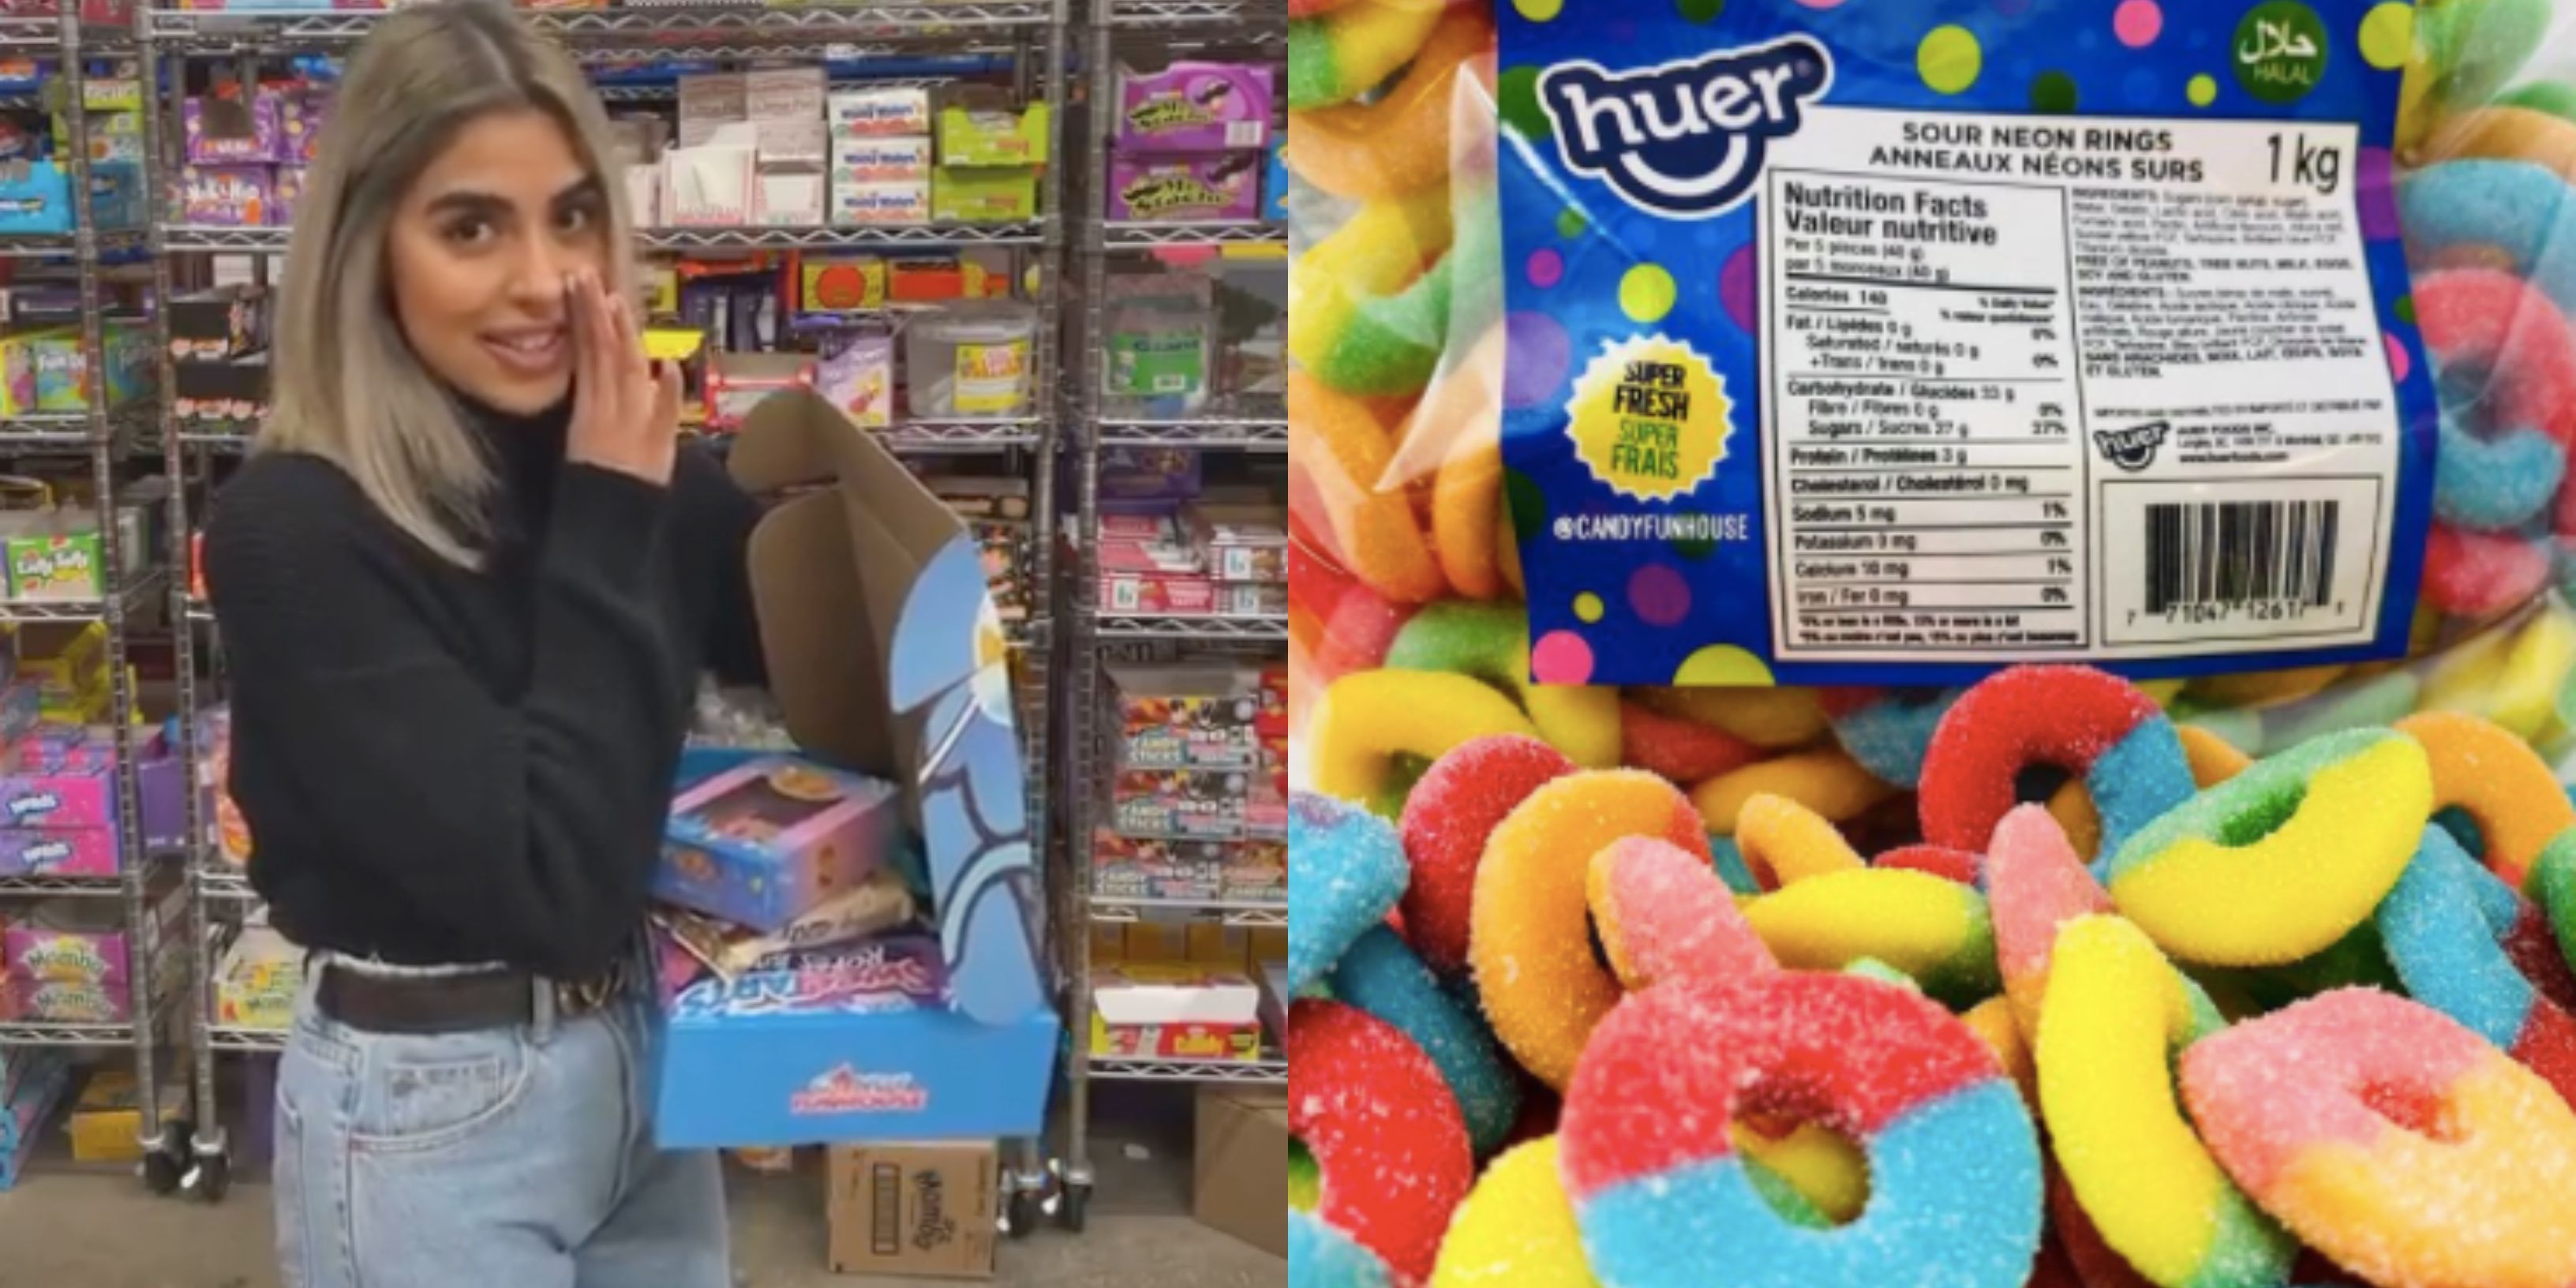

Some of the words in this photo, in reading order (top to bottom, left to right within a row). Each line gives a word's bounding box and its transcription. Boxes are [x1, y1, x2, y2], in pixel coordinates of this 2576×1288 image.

[2239, 18, 2318, 64] حلال
[2252, 63, 2312, 85] HALAL
[1902, 122, 1983, 145] SOUR
[1991, 126, 2076, 149] NEON
[2084, 129, 2174, 152] RINGS
[1869, 146, 2012, 173] ANNEAUX
[2022, 152, 2122, 178] NÉONS
[2130, 159, 2203, 183] SURS
[2267, 133, 2282, 183] 1
[2292, 133, 2339, 194] kg
[1784, 181, 1905, 213] Nutrition
[1914, 189, 1989, 218] Facts
[1783, 208, 1873, 237] Valeur
[1881, 218, 1999, 246] nutritive
[1784, 237, 1810, 252] Per
[1785, 286, 1849, 303] Calories
[1826, 316, 1883, 335] Lipides
[1805, 335, 1881, 353] Saturated
[1623, 360, 1688, 388] SUPER
[1788, 380, 1896, 399] Carbohydrate
[1612, 384, 1690, 421] FRESH
[1863, 402, 1911, 417] Fibres
[1619, 419, 1679, 447] SUPER
[1807, 419, 1863, 440] Sugars
[1878, 419, 1931, 436] Sucres
[1612, 444, 1679, 480] FRAIS
[1790, 446, 1848, 464] Protein
[1791, 475, 1881, 493] Cholesterol
[2005, 476, 2030, 494] mg
[1792, 504, 1853, 522] Sodium
[1870, 506, 1896, 523] mg
[1552, 513, 1748, 540] @CANDYFUNHOUSE
[1794, 534, 1874, 551] Potassium
[1892, 534, 1917, 552] mg
[1795, 561, 1857, 578] Calcium
[1883, 563, 1909, 581] mg
[1796, 589, 1827, 605] Iron
[1841, 588, 1866, 605] Fer
[1883, 589, 1909, 607] mg
